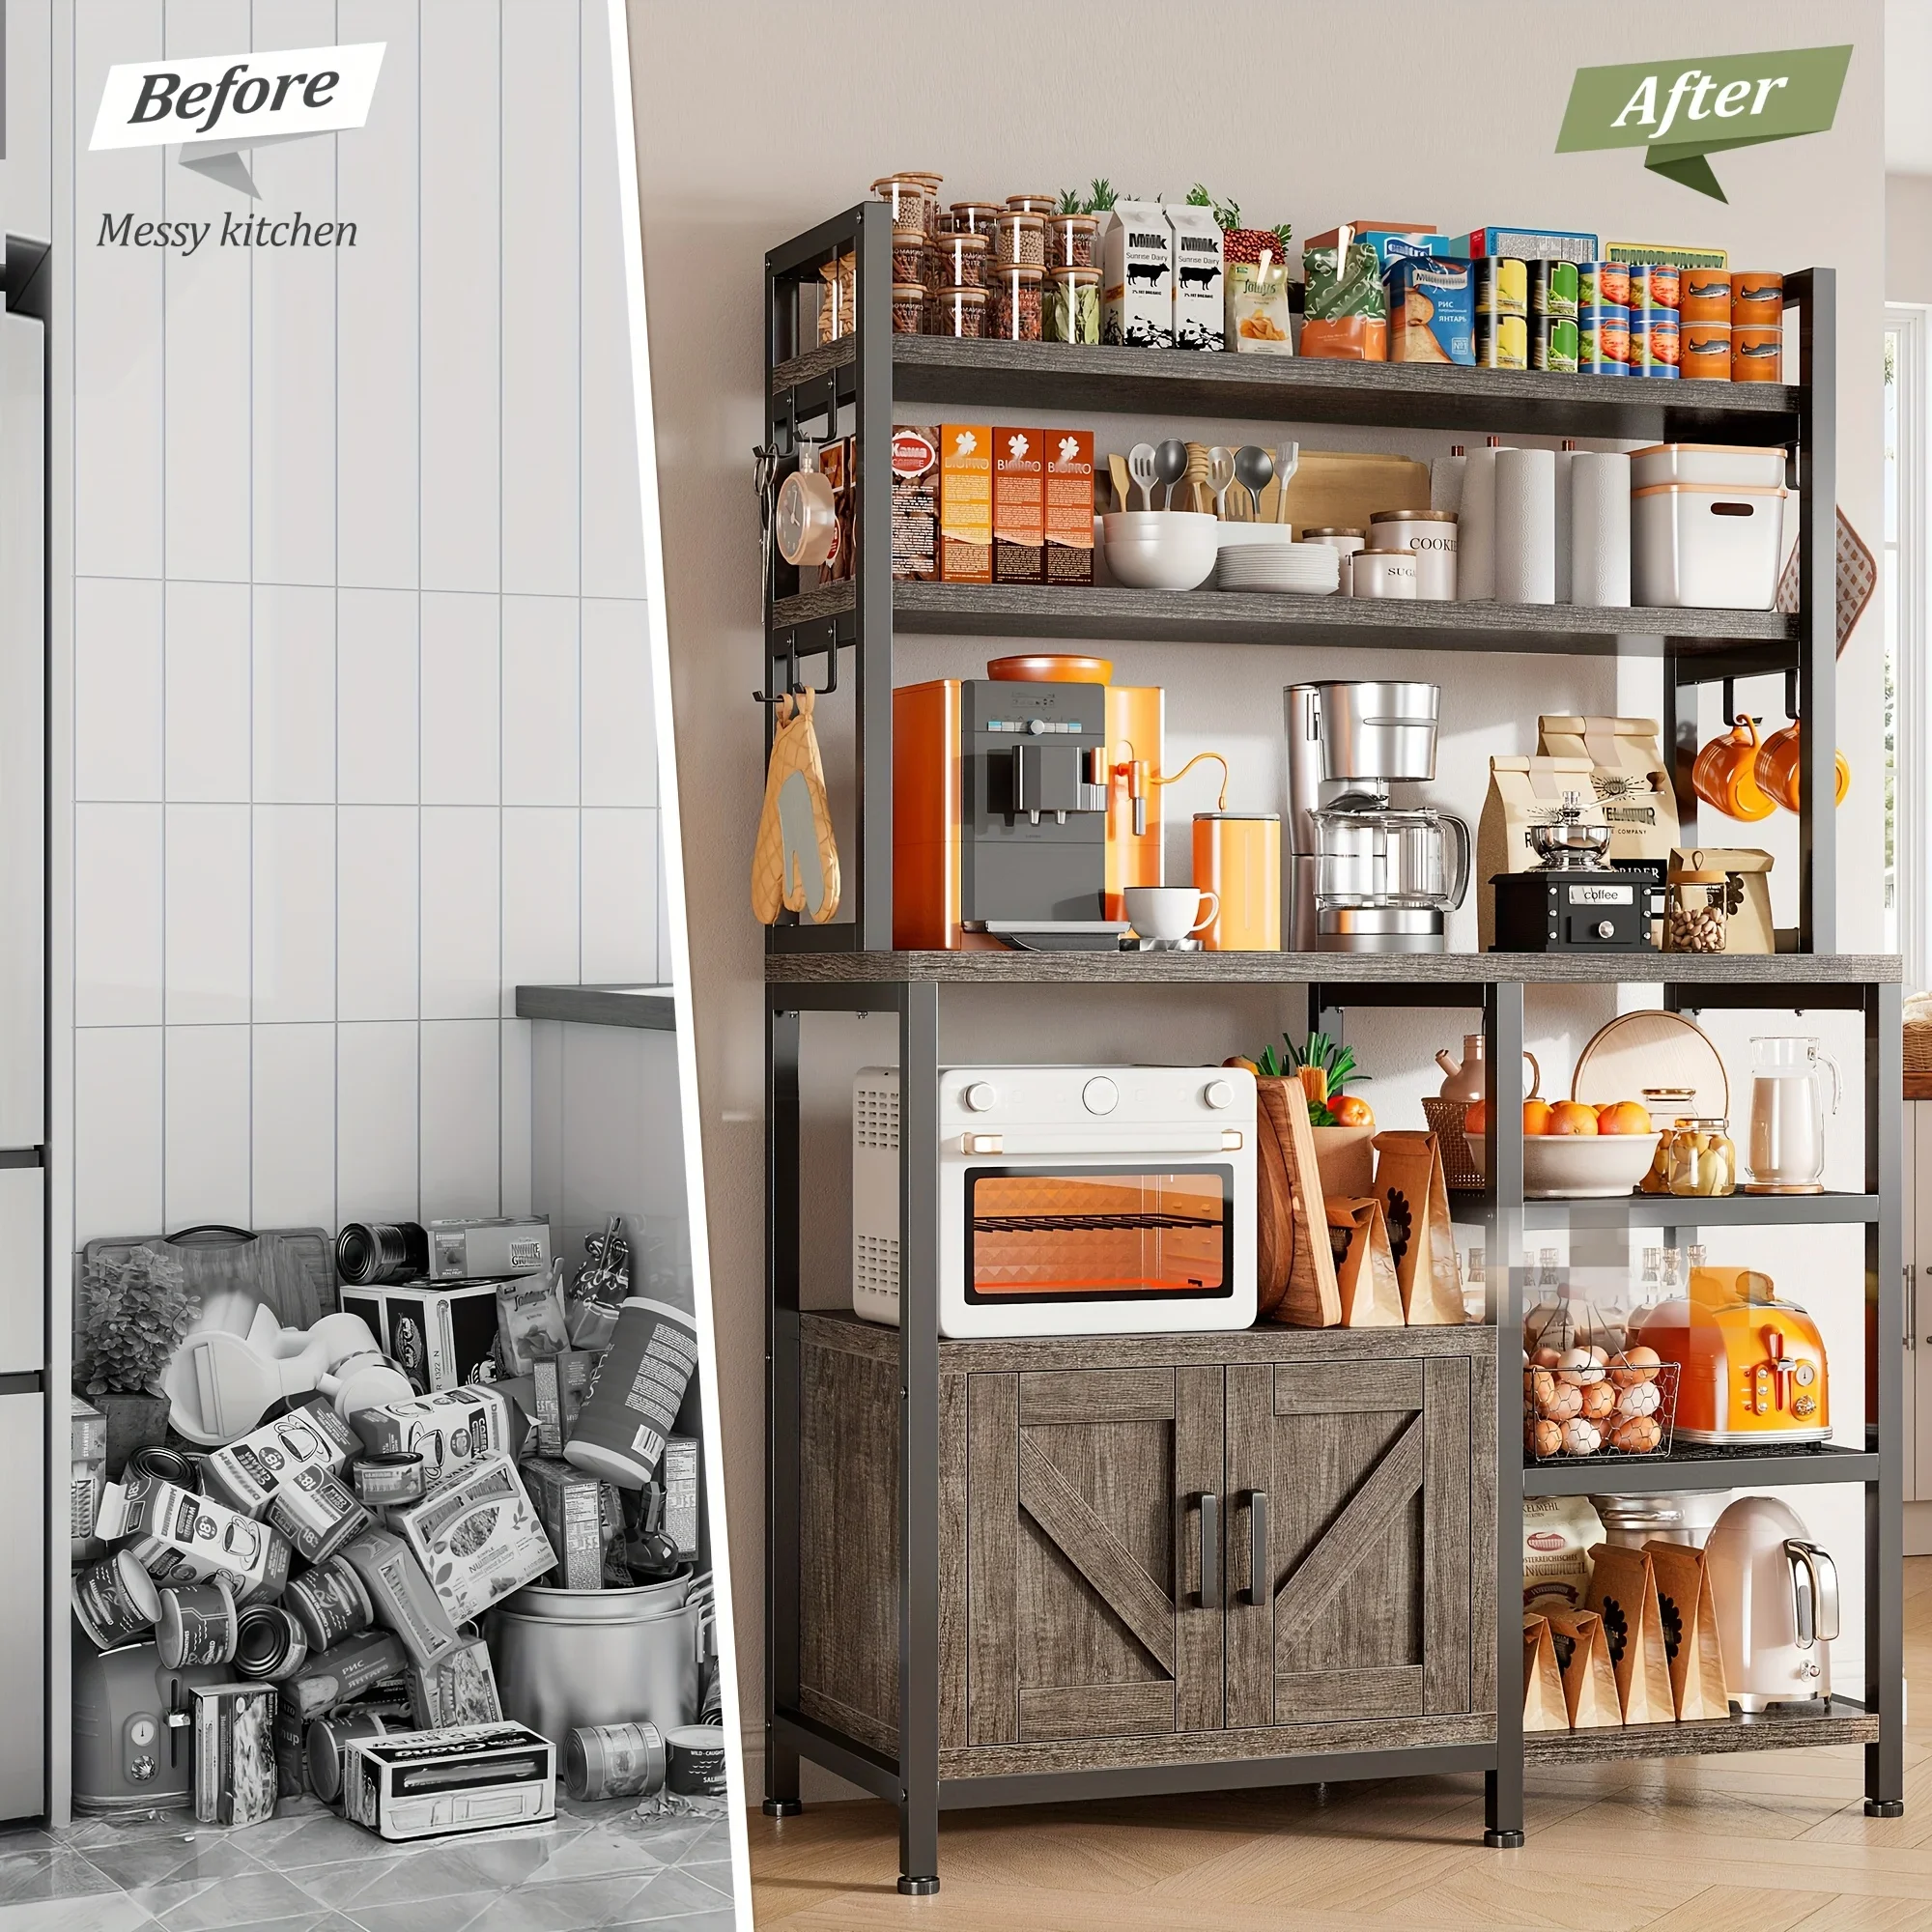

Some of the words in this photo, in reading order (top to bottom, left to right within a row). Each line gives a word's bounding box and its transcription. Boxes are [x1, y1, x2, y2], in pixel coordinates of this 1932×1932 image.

[1126, 251, 1150, 261] Sunrise
[1151, 253, 1168, 263] Dairy
[1178, 255, 1202, 264] Sunrise
[1203, 256, 1220, 266] Dairy
[1584, 888, 1618, 900] coffee
[448, 1456, 489, 1478] VALLEY
[341, 1660, 365, 1675] РИС
